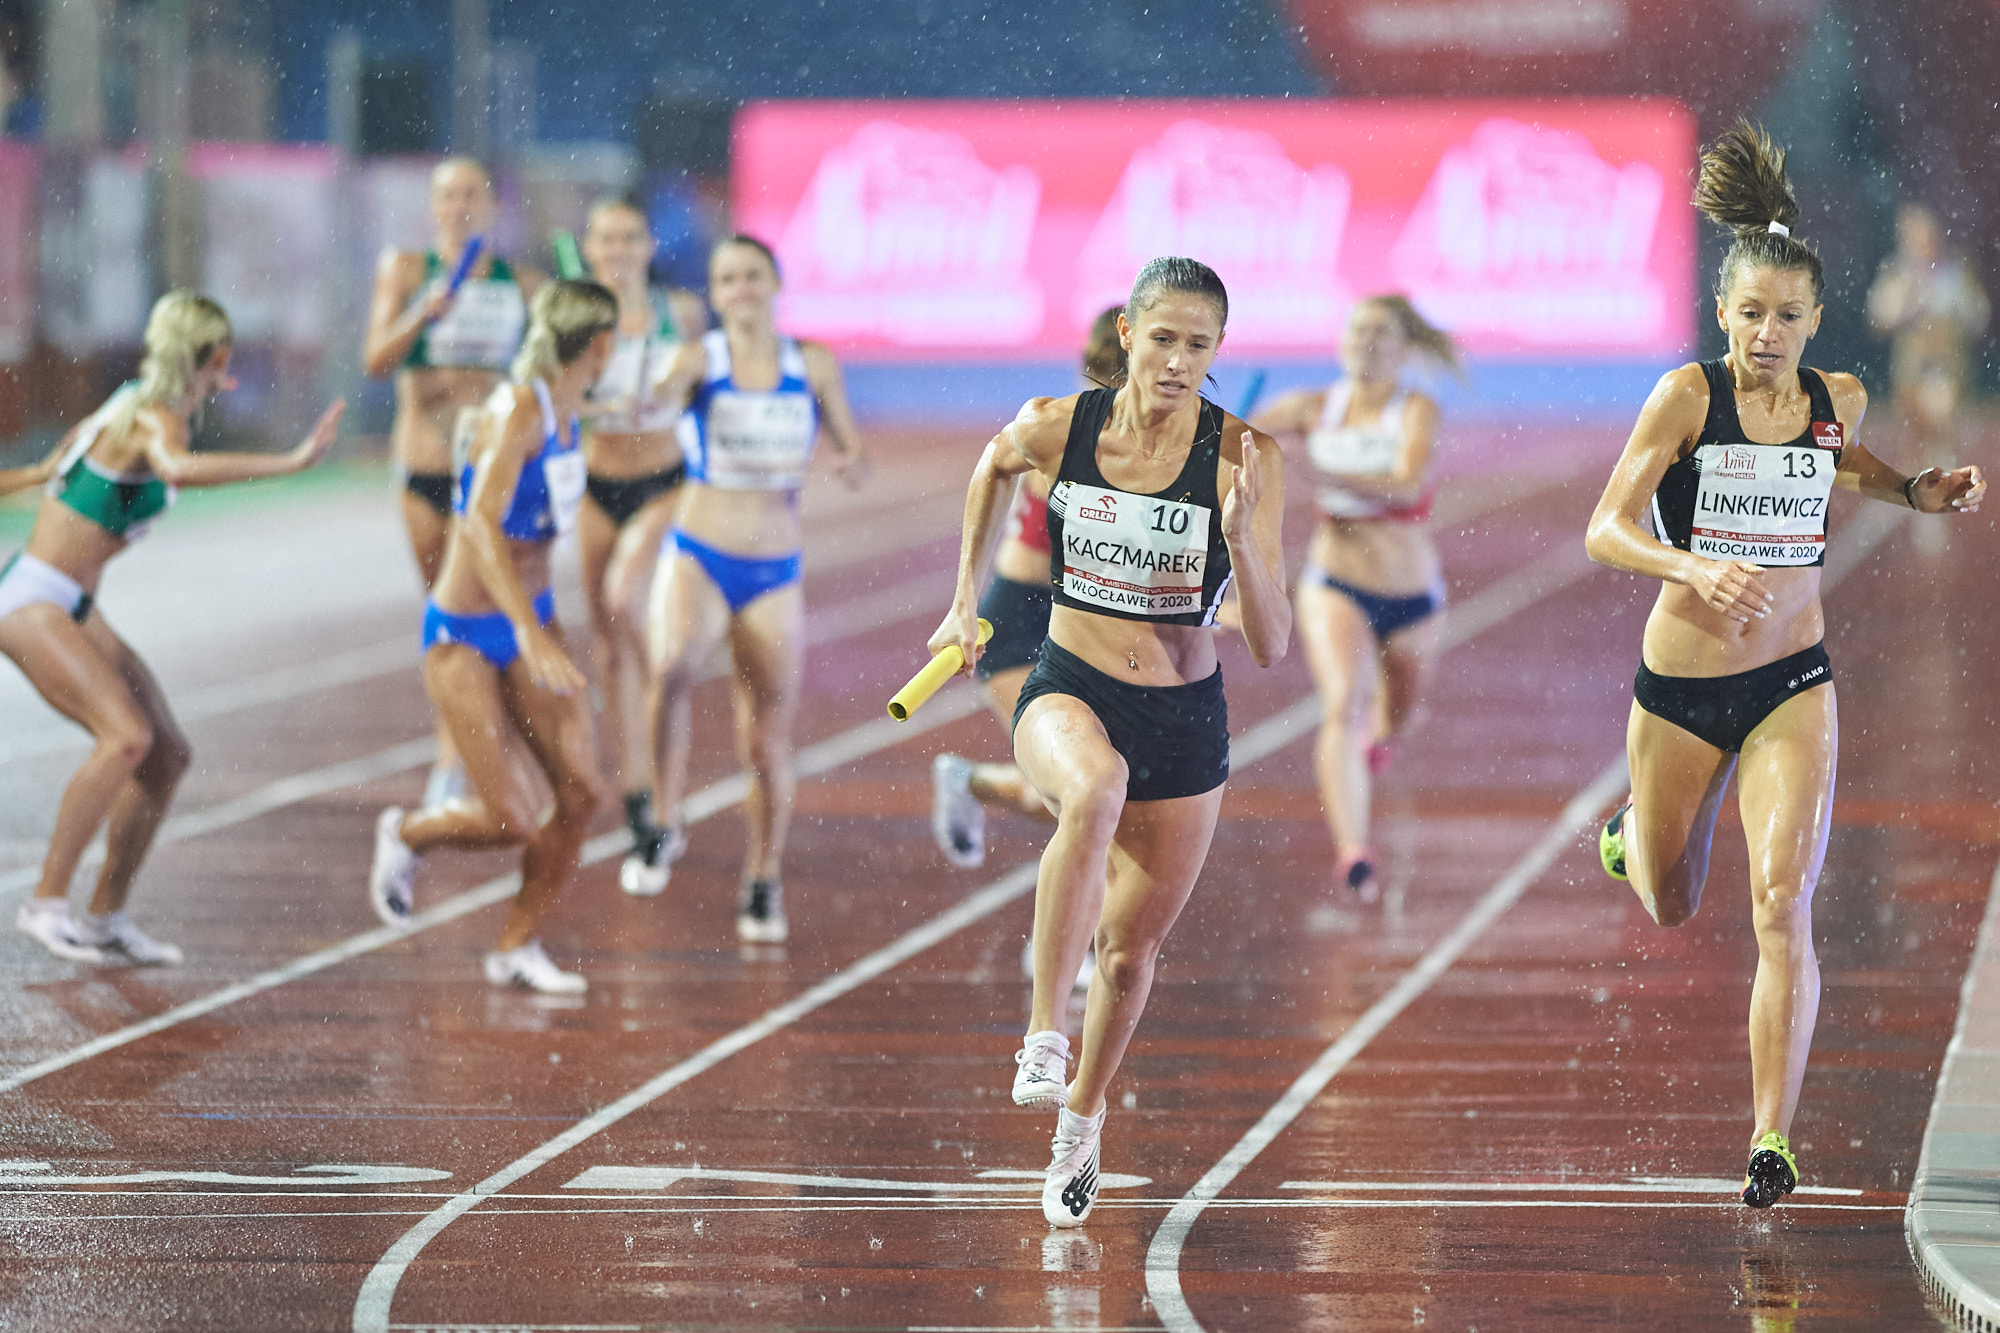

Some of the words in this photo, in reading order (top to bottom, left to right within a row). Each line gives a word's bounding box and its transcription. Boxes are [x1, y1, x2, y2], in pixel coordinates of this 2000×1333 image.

[1818, 437, 1840, 445] ORLEN
[1716, 450, 1757, 470] Anwil
[1783, 452, 1817, 479] 13
[1701, 491, 1824, 518] LINKIEWICZ
[1080, 508, 1116, 523] ORLEN
[1150, 504, 1189, 535] 10
[1715, 531, 1738, 540] PZLA
[1738, 534, 1792, 543] MISTRZOSTWA
[1067, 535, 1201, 573] KACZMAREK
[1699, 539, 1786, 558] WŁOCŁAWEK
[1790, 546, 1817, 558] 2020
[1072, 578, 1156, 609] WŁOCŁAWEK
[1160, 595, 1193, 609] 2020
[1801, 665, 1824, 683] JAKO
